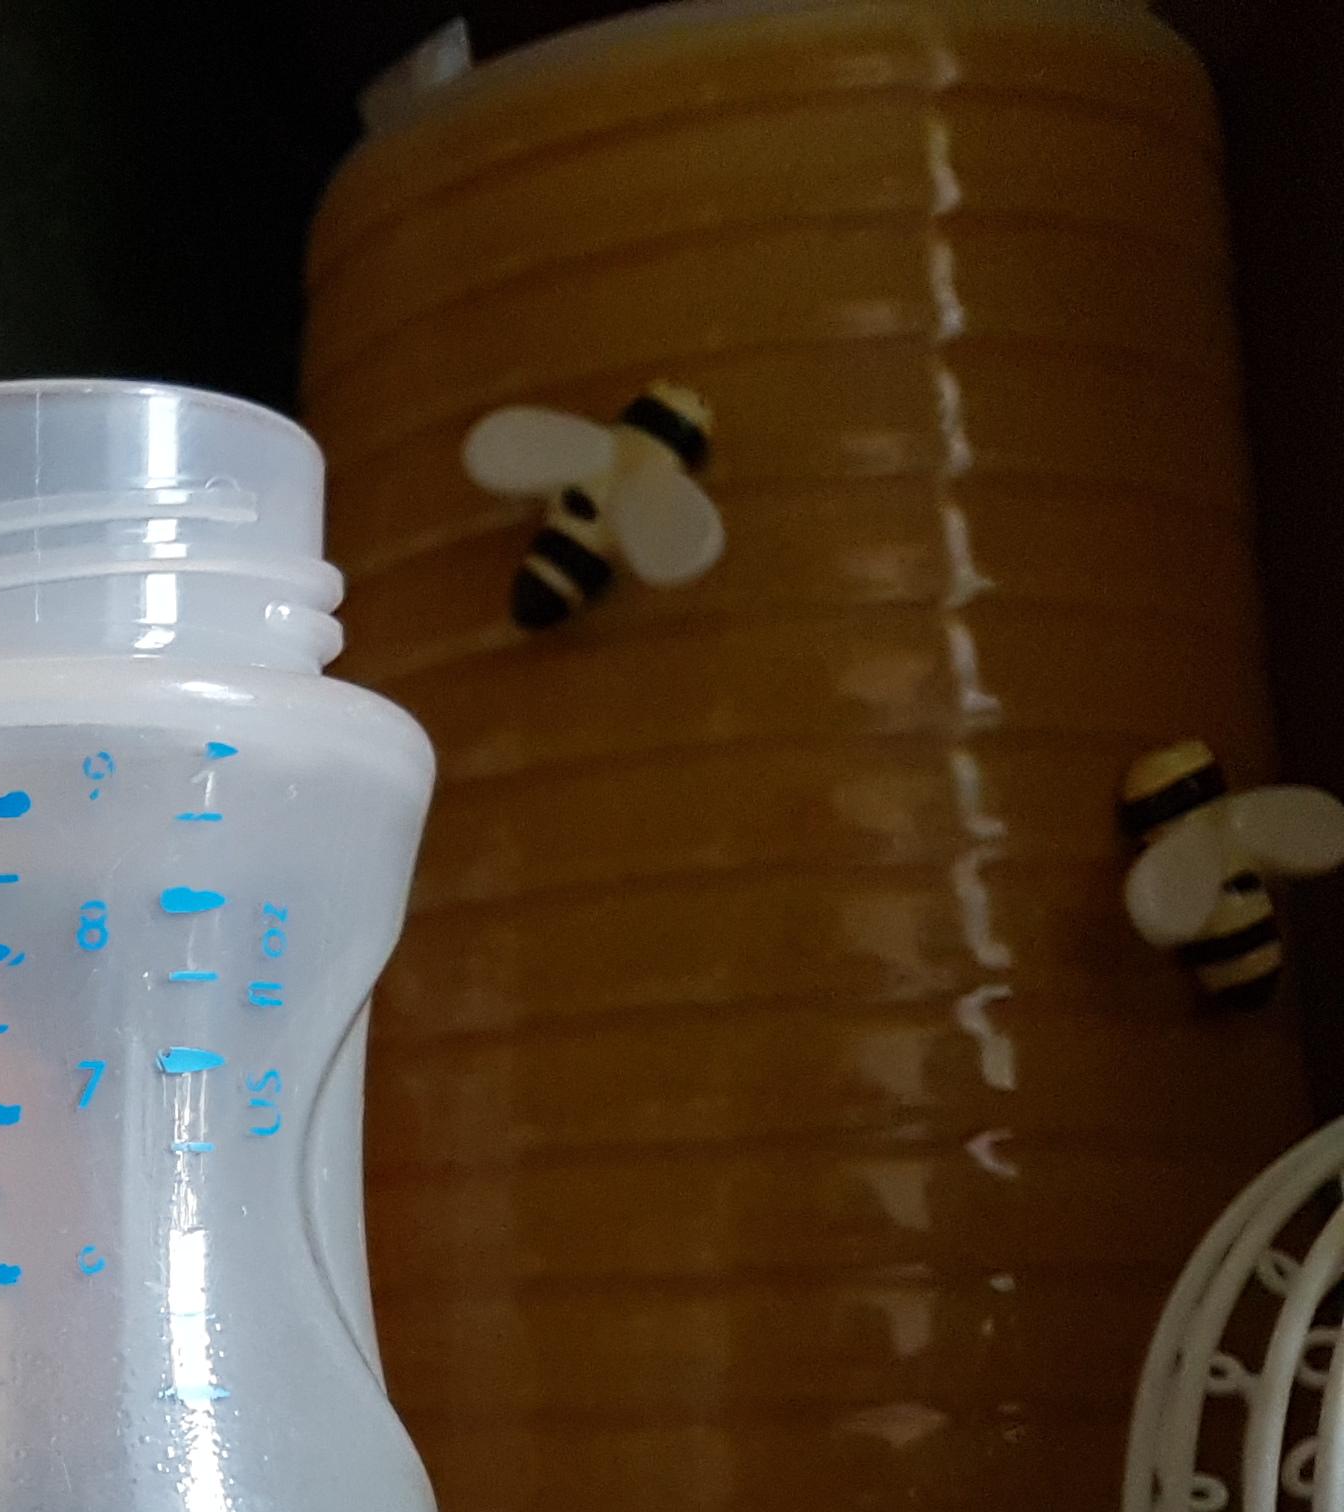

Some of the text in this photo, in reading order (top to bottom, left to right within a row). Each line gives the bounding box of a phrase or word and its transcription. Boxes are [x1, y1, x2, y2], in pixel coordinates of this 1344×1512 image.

[74, 898, 111, 953] 8
[261, 901, 290, 960] oz
[75, 1058, 109, 1111] 7
[245, 1068, 283, 1137] US
